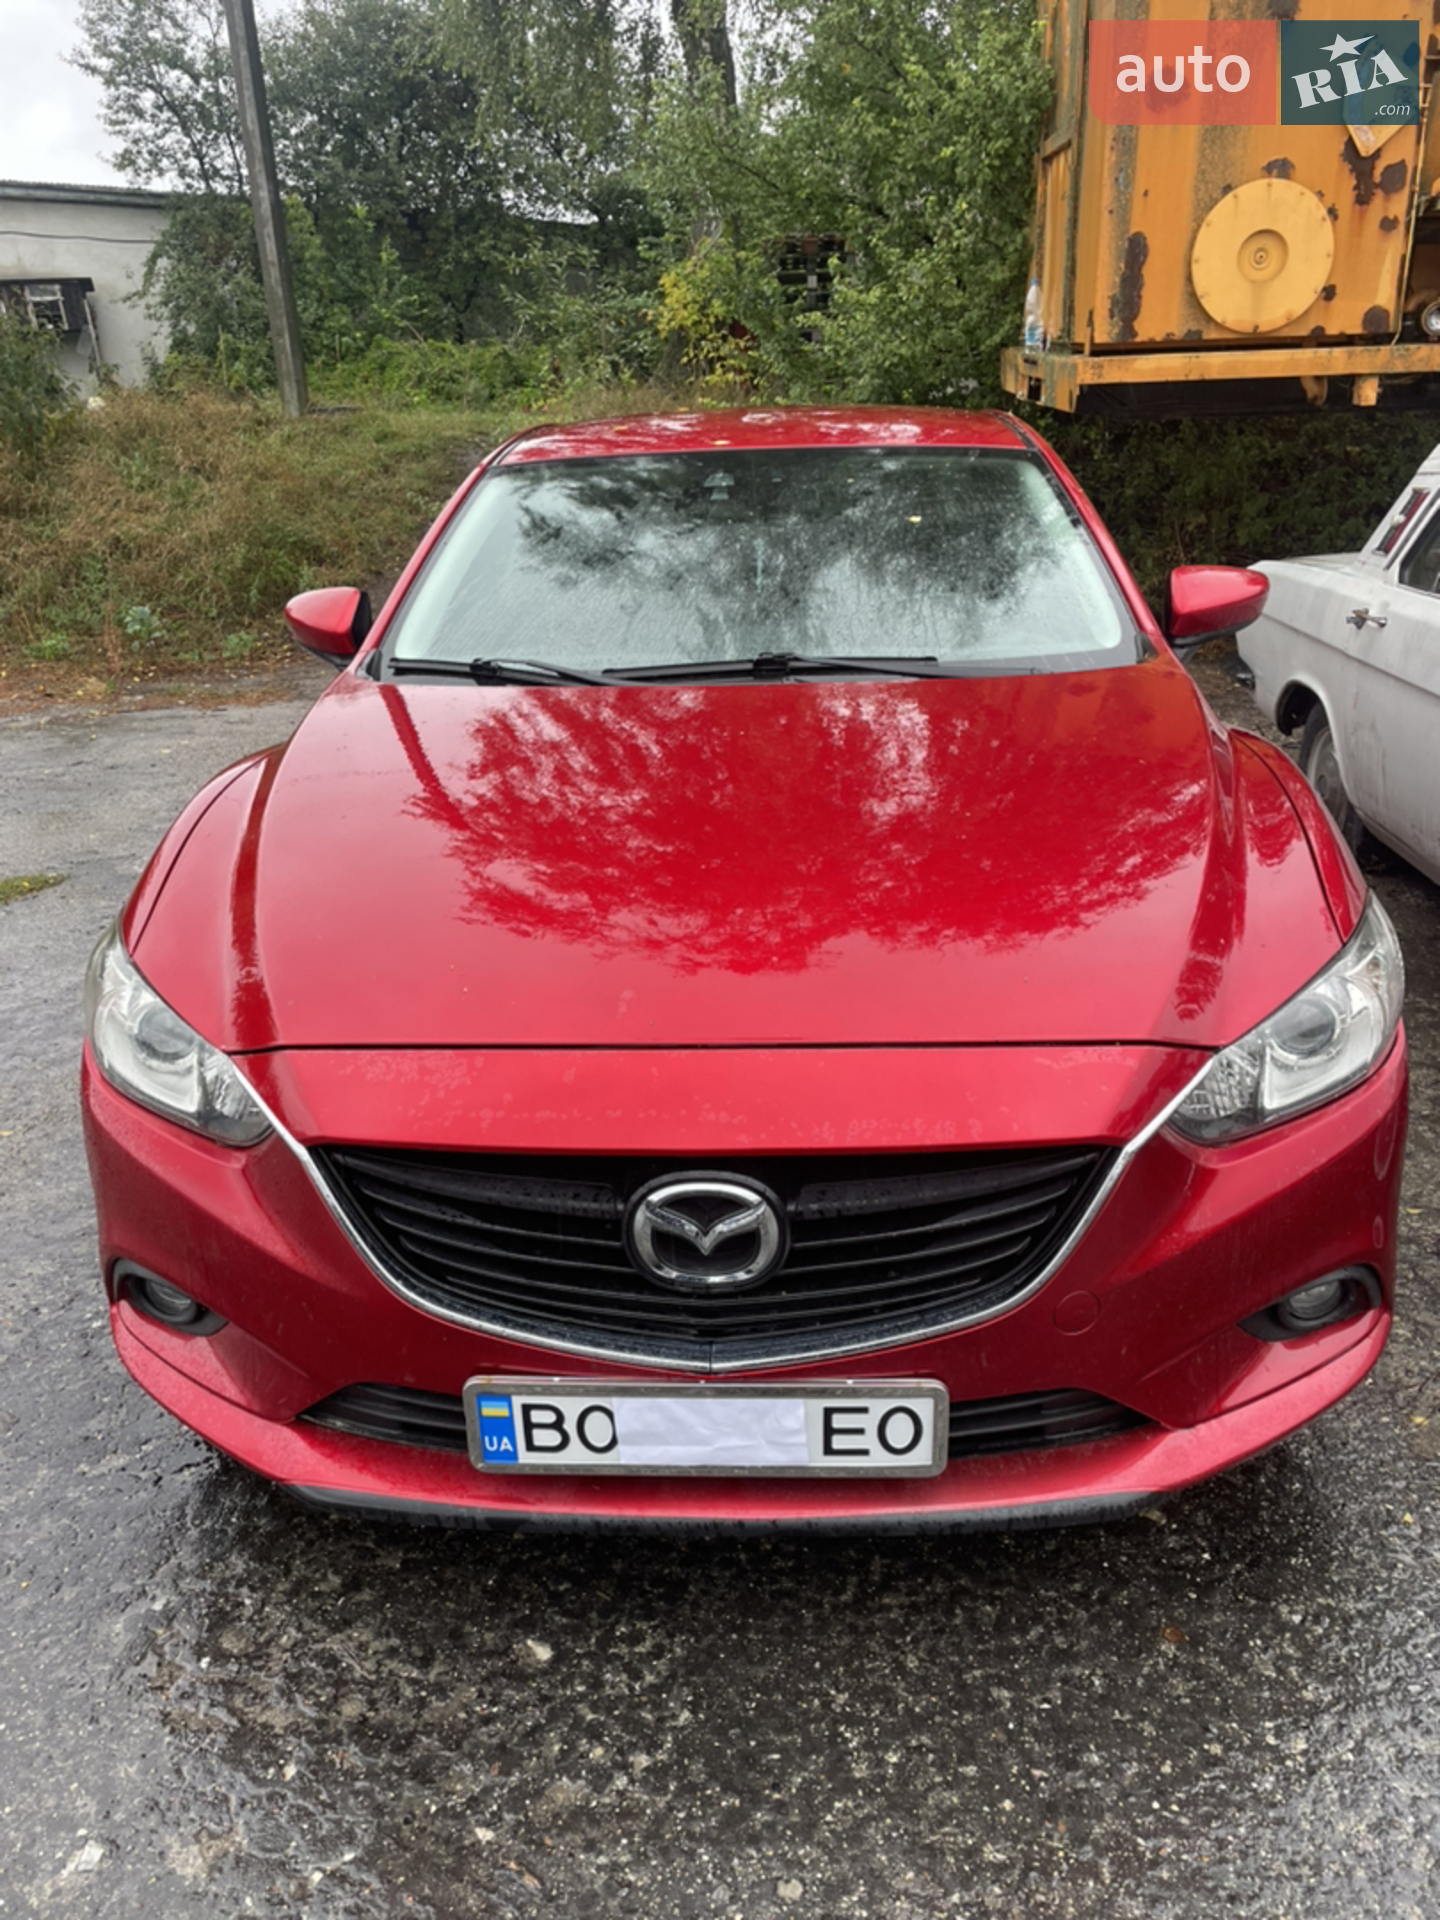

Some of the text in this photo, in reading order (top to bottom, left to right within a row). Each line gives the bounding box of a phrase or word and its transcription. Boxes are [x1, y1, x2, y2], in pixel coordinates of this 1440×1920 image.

[484, 1436, 514, 1452] UA
[521, 1403, 923, 1456] BO EO
